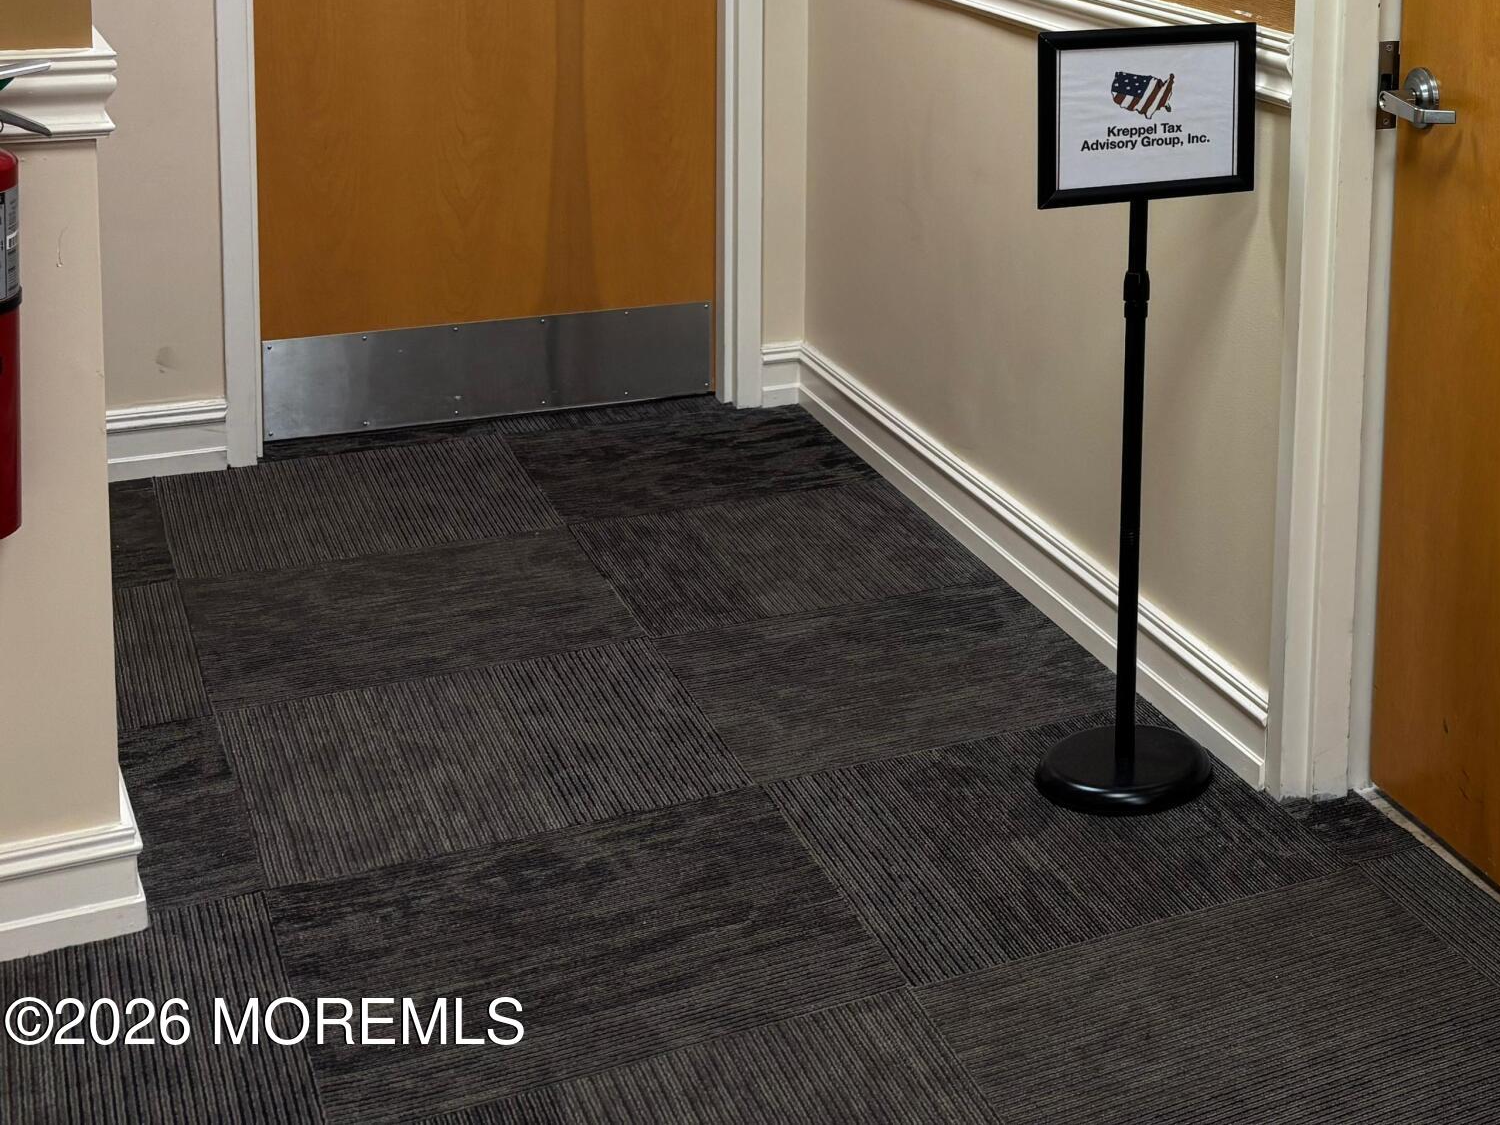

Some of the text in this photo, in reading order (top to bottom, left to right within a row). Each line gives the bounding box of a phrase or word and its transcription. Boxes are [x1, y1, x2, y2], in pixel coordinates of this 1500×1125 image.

[1107, 122, 1183, 139] Kreppel Tax
[1081, 132, 1211, 152] Advisory Group, Inc.
